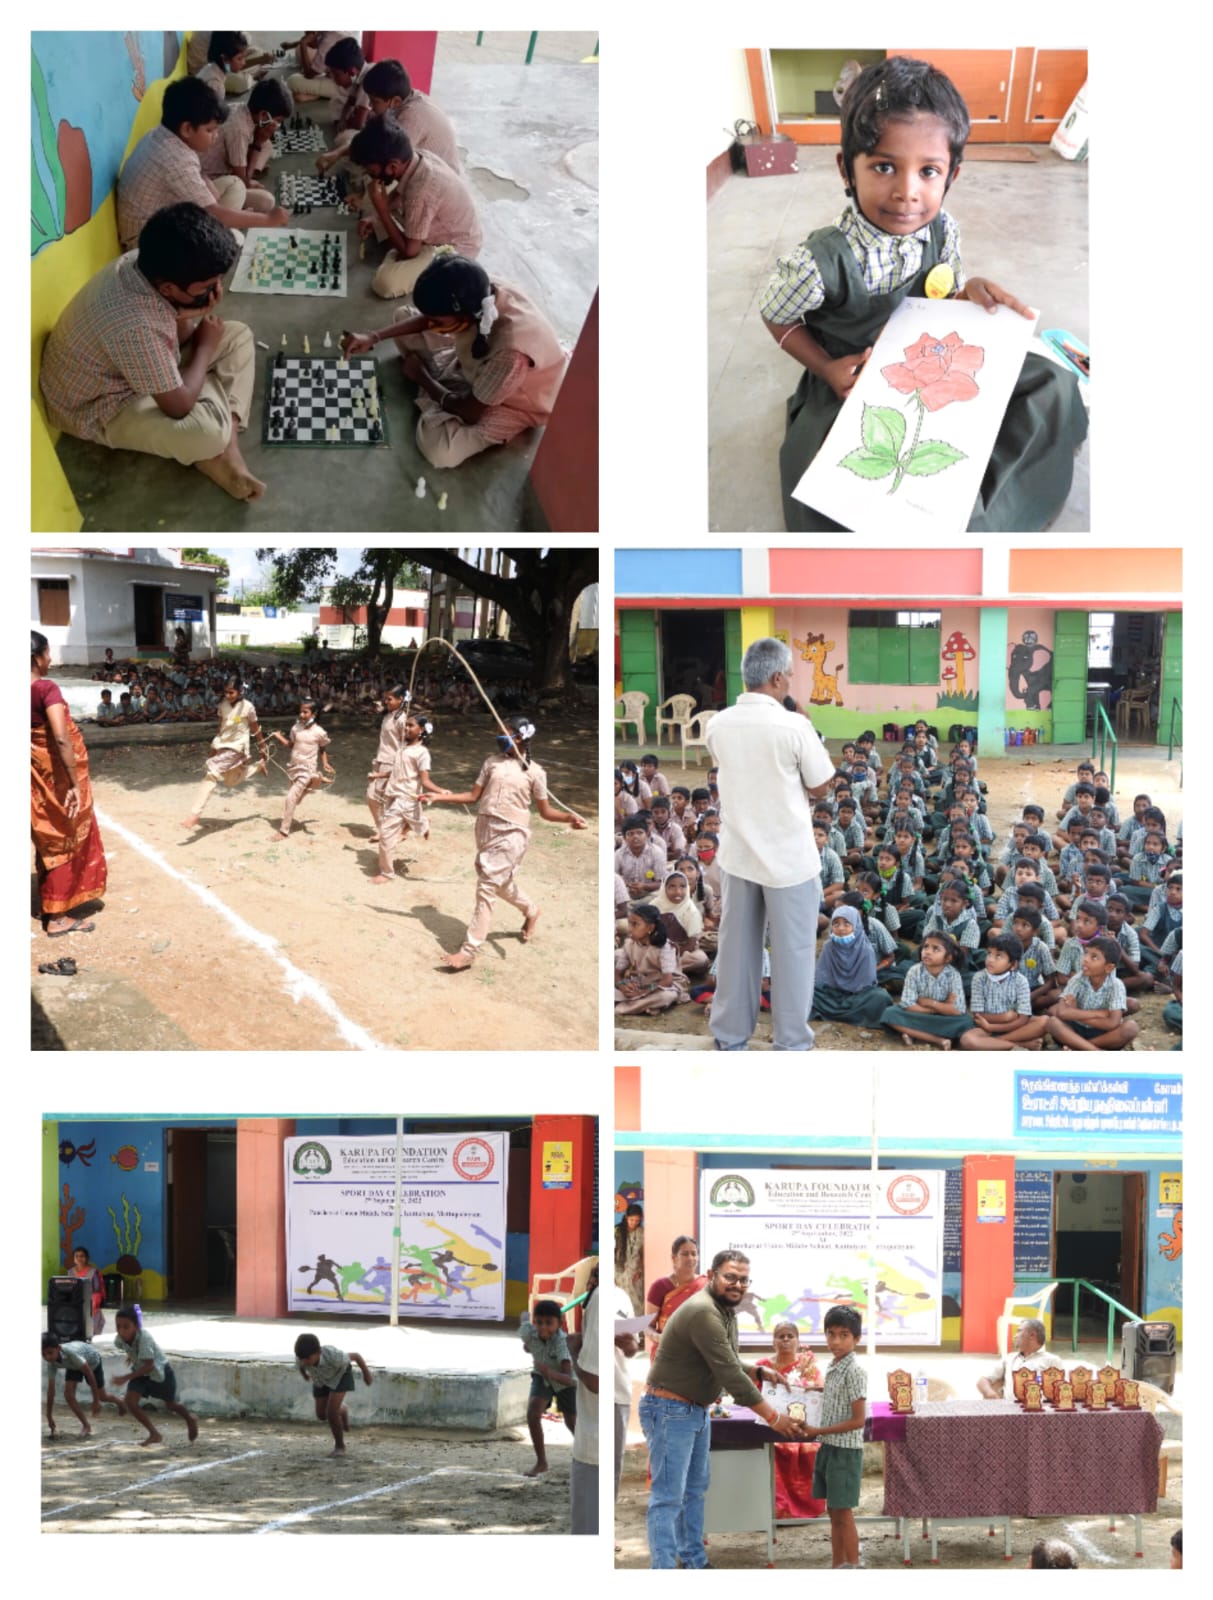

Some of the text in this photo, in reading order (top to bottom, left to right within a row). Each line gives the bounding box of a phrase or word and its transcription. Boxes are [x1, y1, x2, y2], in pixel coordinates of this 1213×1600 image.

[340, 1146, 448, 1157] KARUPA FONDATION
[764, 1181, 809, 1191] KARUPA
[340, 1189, 446, 1197] SPORT DAY CEEBRATION
[764, 1222, 793, 1230] SPORT
[795, 1222, 813, 1230] DAY
